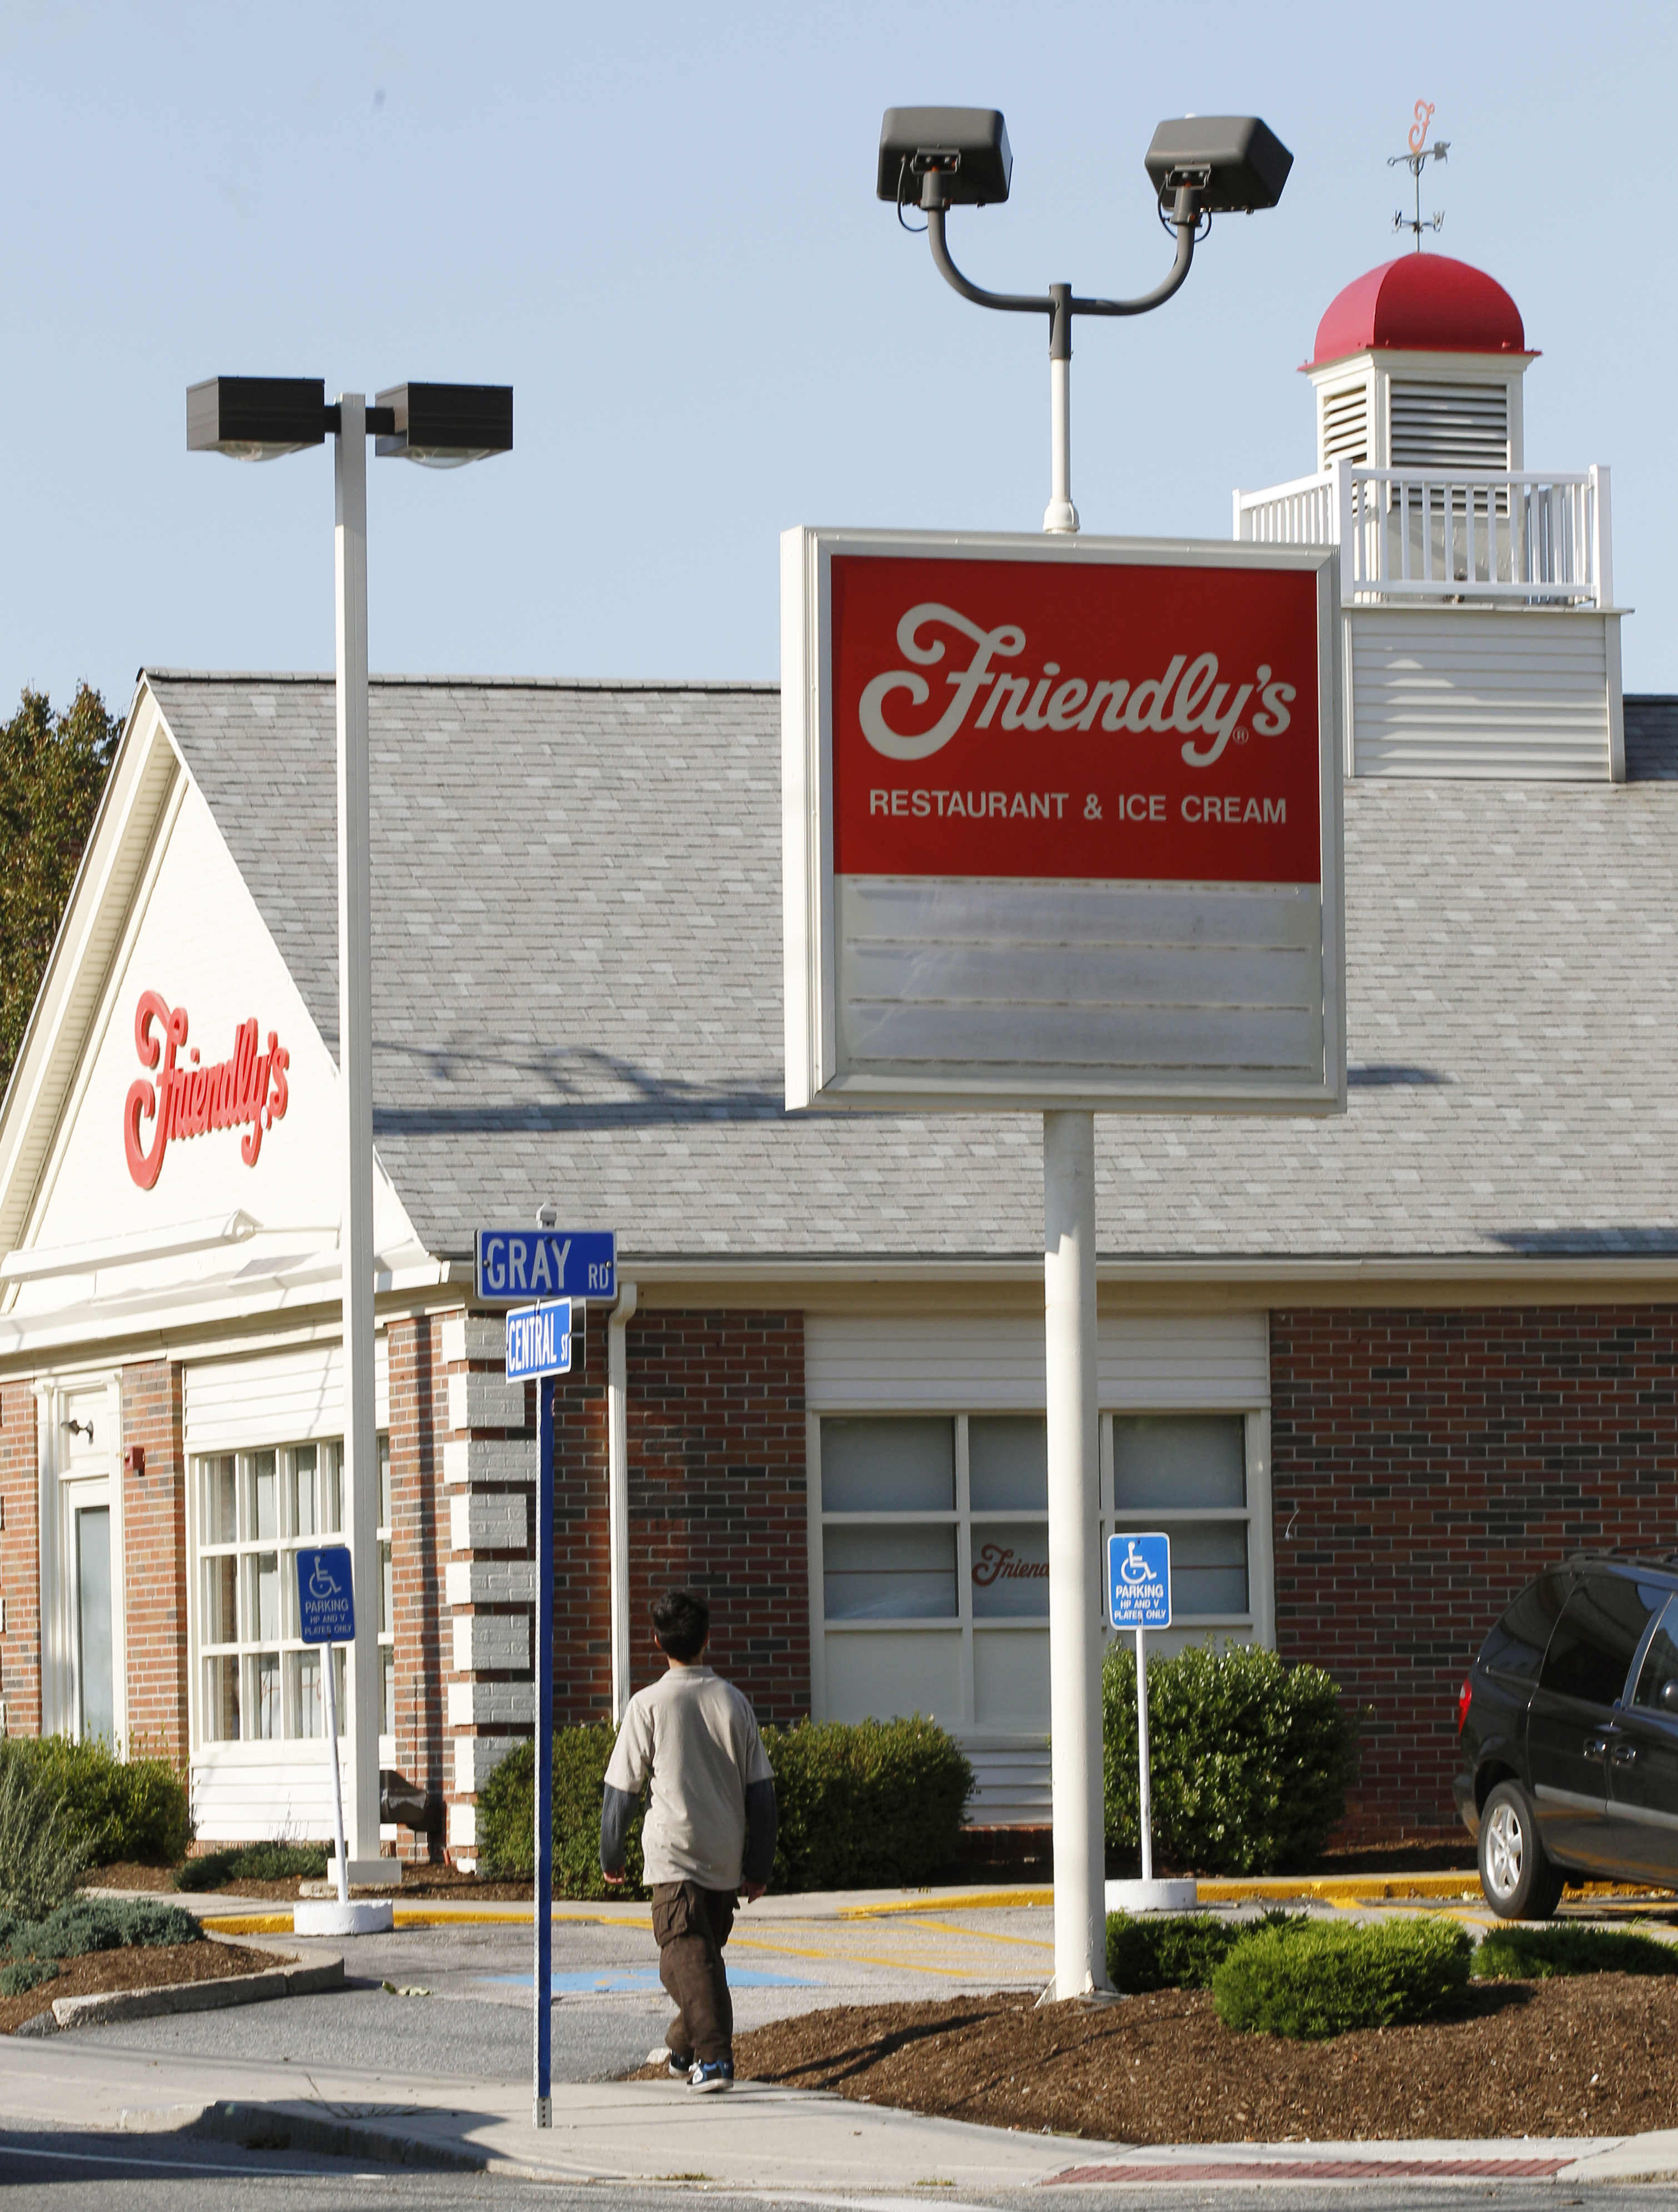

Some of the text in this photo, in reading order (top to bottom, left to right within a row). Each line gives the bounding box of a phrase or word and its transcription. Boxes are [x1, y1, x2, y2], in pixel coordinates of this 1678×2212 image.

[858, 602, 1297, 768] Friendly's
[870, 789, 1287, 824] RESTAURANT & ICE CREAM
[123, 990, 290, 1190] Friendly's
[487, 1238, 609, 1289] GRAY RD
[508, 1312, 569, 1372] CENTRAL ST
[1116, 1584, 1164, 1599] PARKING
[1120, 1599, 1159, 1609] HP AND V
[306, 1599, 349, 1613] PARKING
[1114, 1609, 1166, 1620] PLATES ONLY
[305, 1623, 352, 1635] PLATES ONLY
